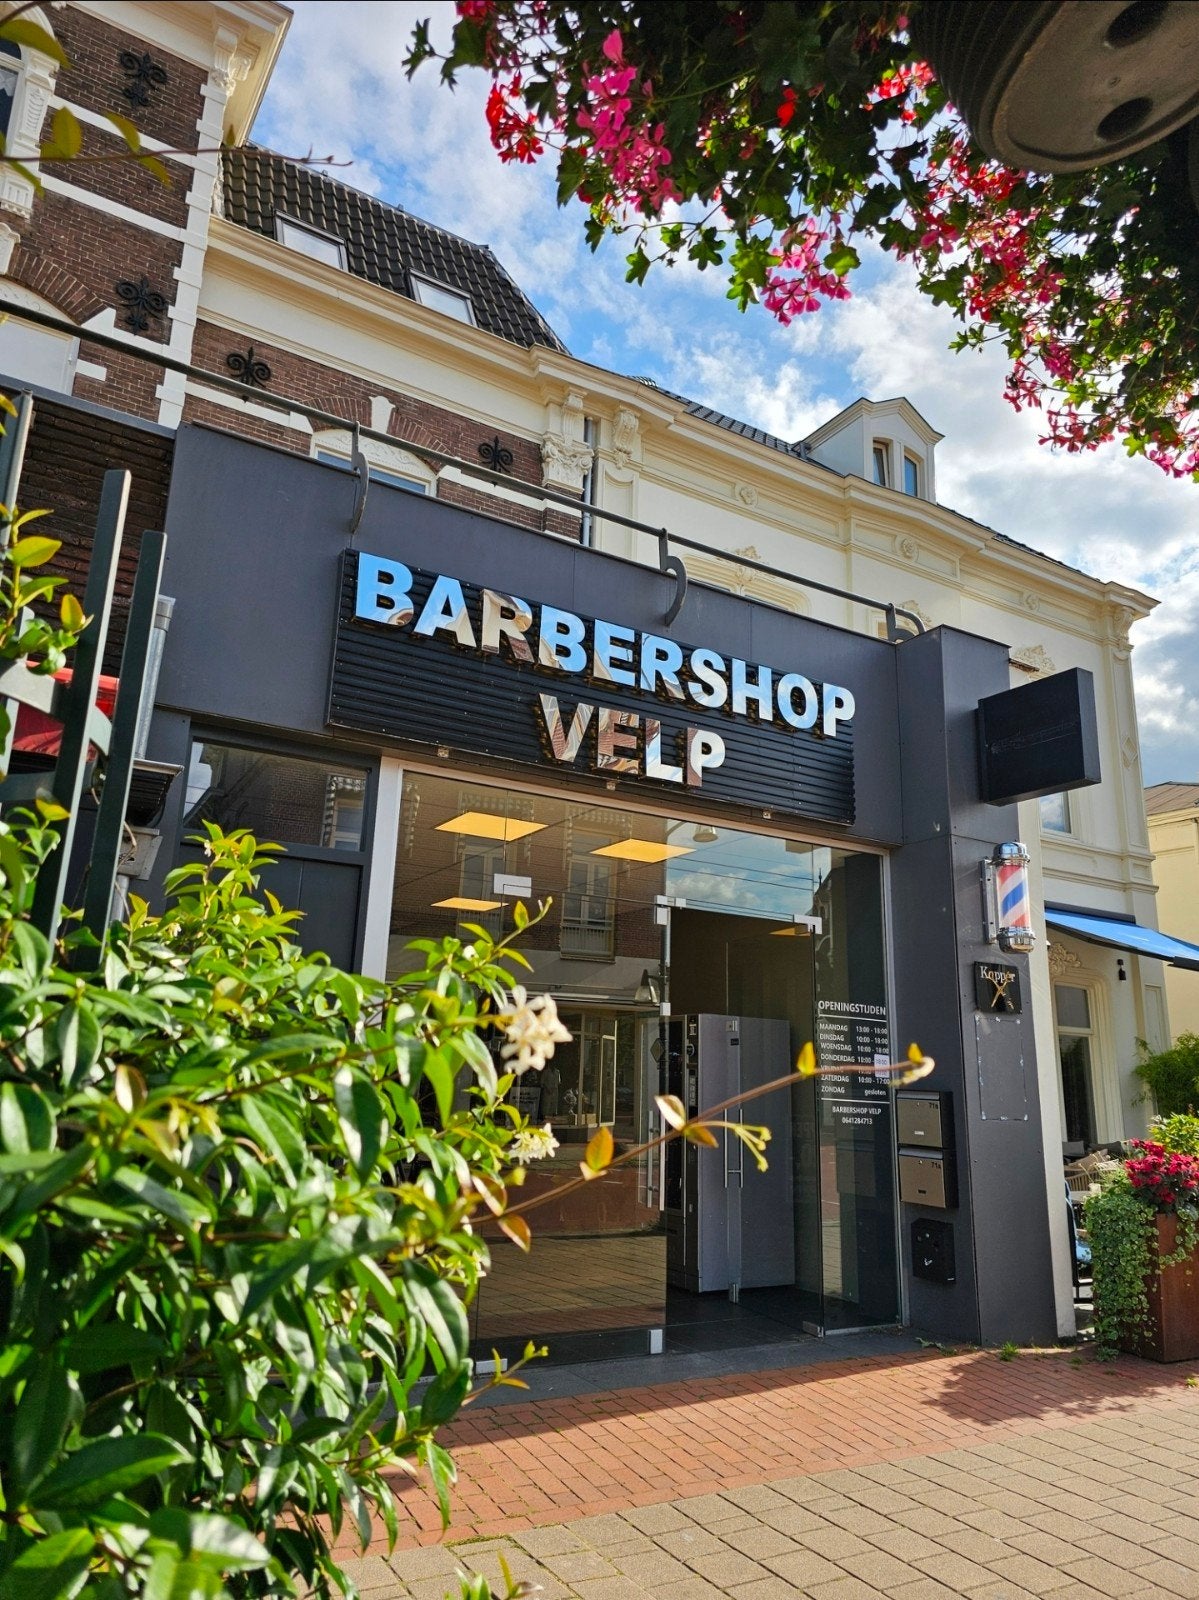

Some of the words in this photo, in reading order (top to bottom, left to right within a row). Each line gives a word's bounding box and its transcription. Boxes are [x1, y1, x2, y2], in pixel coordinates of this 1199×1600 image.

[355, 551, 857, 738] BARBERSHOP
[538, 693, 726, 788] VELP
[818, 1000, 886, 1015] OPENINGSTIJDEN
[819, 1023, 848, 1032] MAANDAG
[819, 1033, 845, 1042] DINSDAG
[820, 1042, 852, 1051] WOENSDAG
[820, 1053, 855, 1063] DONDERDAG
[821, 1074, 850, 1083] ZATERDAG
[821, 1085, 845, 1094] ZONDAG
[864, 1089, 887, 1097] gesloten
[832, 1105, 868, 1115] BARBERSHOP
[868, 1107, 882, 1115] VELP
